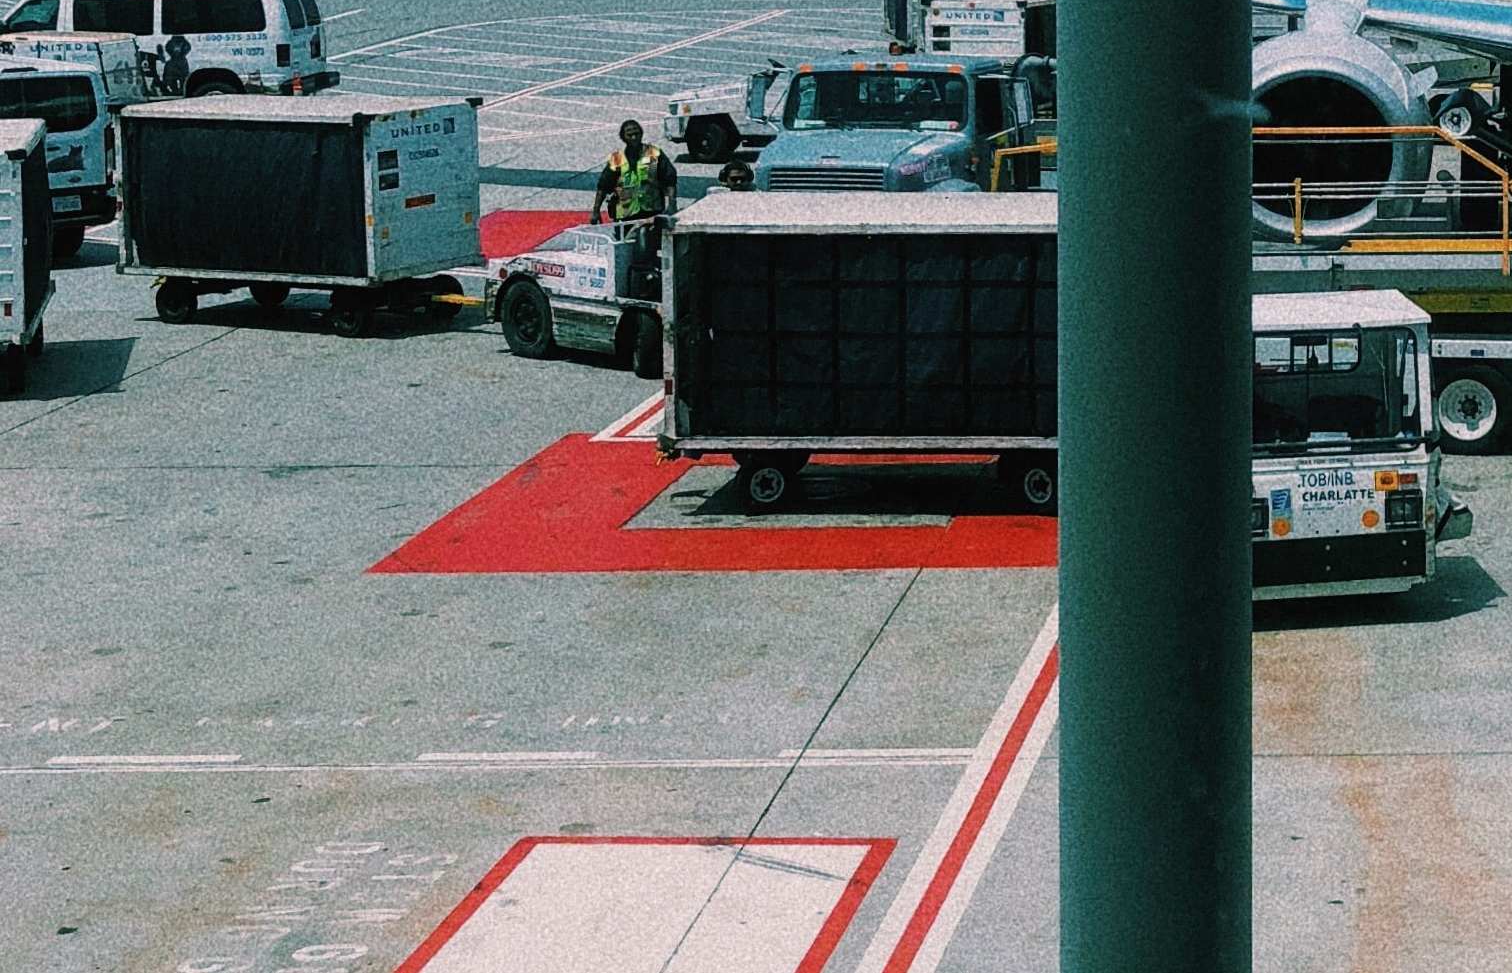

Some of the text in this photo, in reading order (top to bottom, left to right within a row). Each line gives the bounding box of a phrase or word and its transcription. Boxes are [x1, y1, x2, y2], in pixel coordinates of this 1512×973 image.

[946, 12, 991, 20] UNITED
[30, 43, 83, 53] UNITED
[391, 122, 440, 138] UNITED
[569, 266, 598, 275] UNITED
[1302, 489, 1375, 502] CHARLATTE
